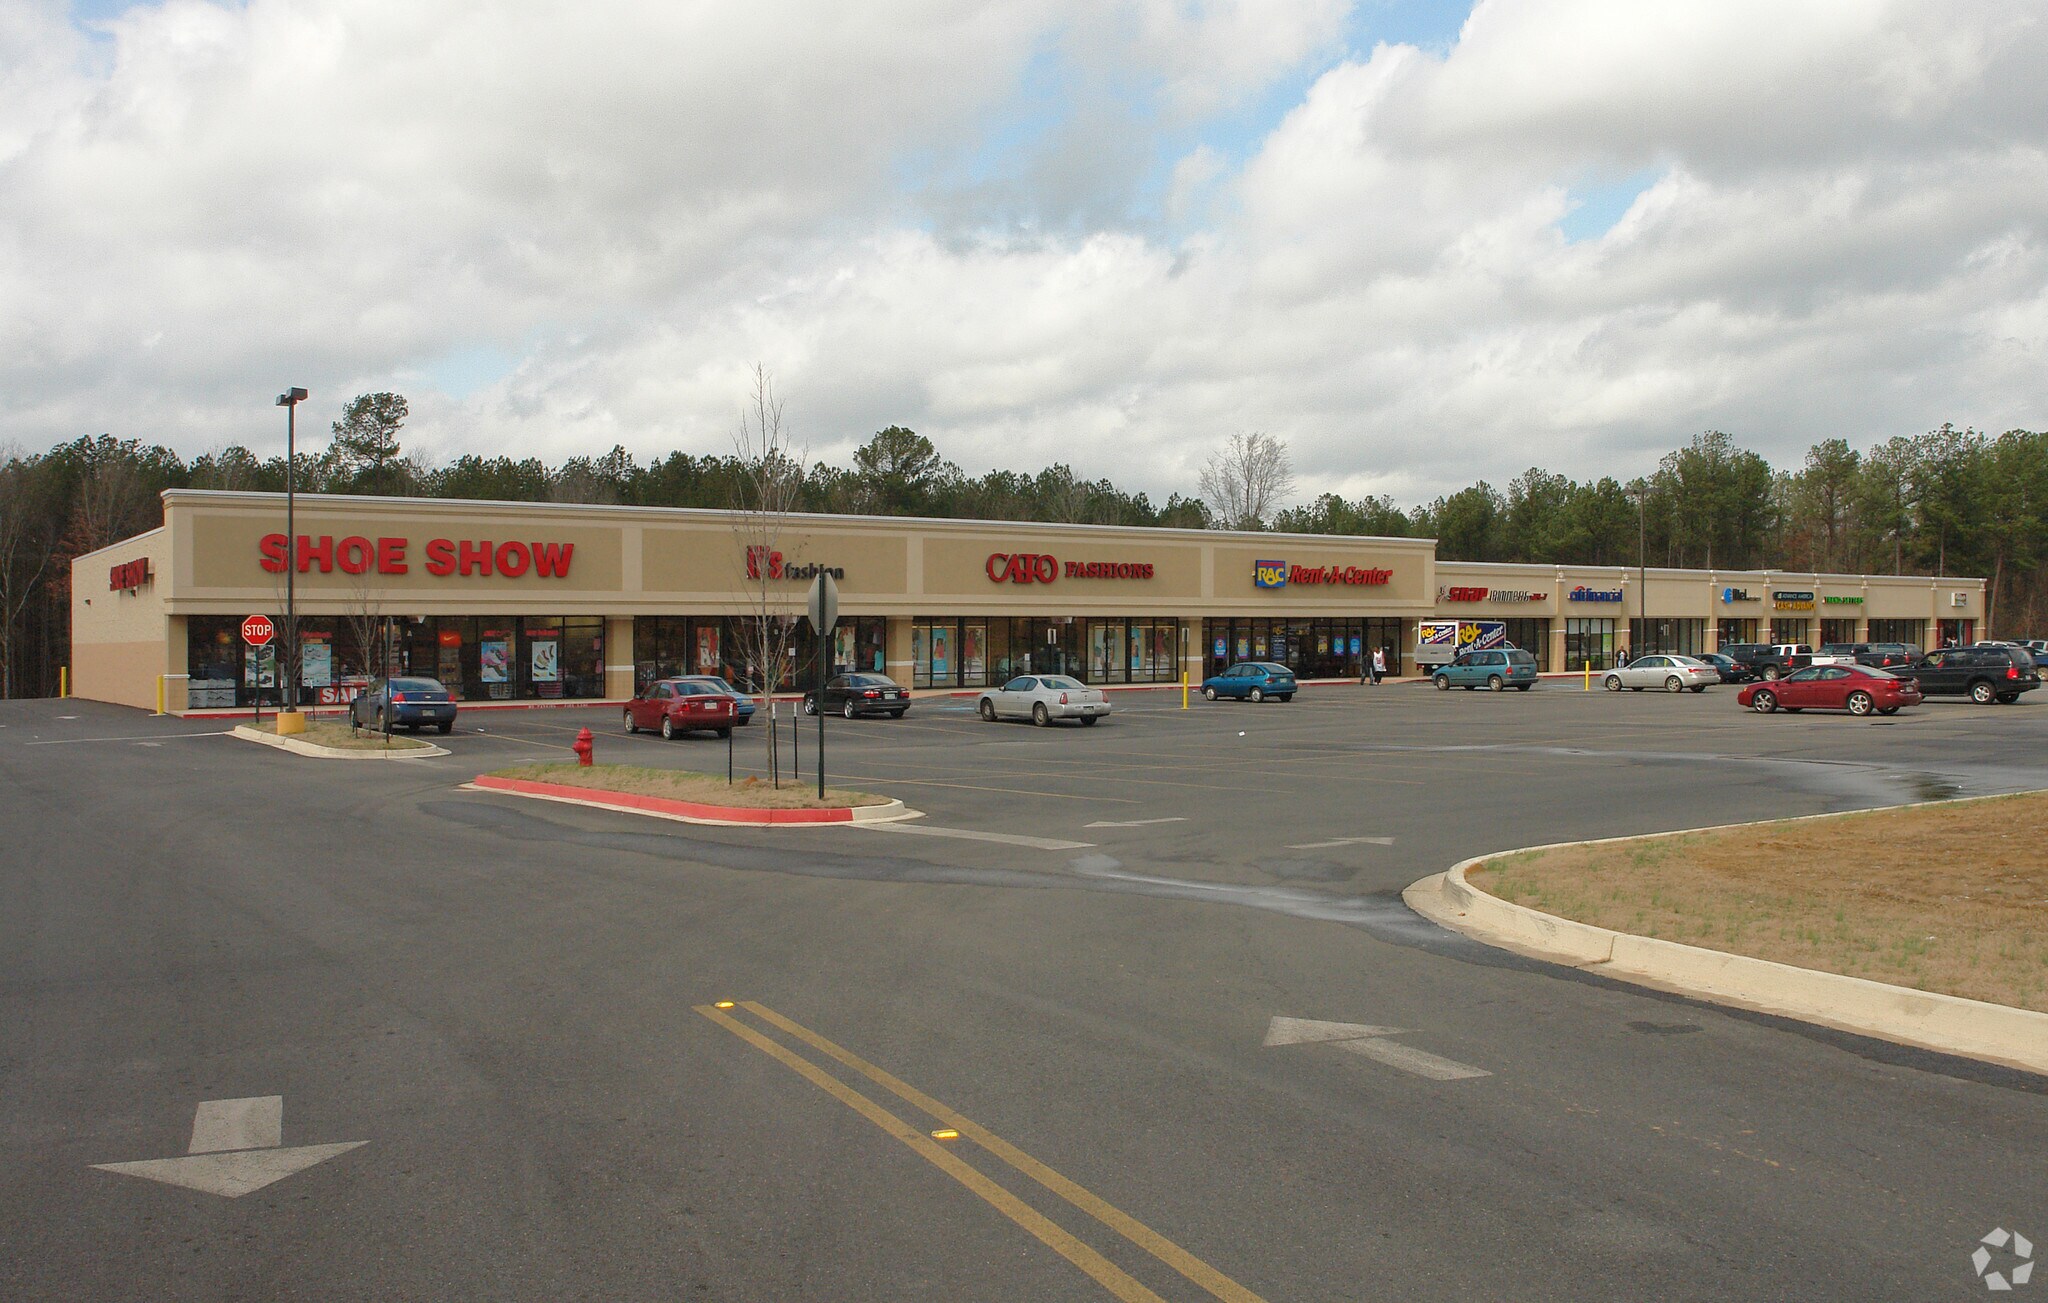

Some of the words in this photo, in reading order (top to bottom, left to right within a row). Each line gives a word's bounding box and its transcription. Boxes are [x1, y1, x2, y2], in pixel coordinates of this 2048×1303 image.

[259, 533, 408, 574] SHOE
[425, 538, 574, 577] SHOW
[986, 553, 1059, 584] CATO
[1065, 561, 1154, 579] FASHIONS
[1257, 567, 1285, 586] RAC
[1777, 601, 1792, 610] CASH
[245, 624, 271, 636] STOP
[1421, 626, 1437, 639] RAC
[1459, 623, 1482, 645] RAC
